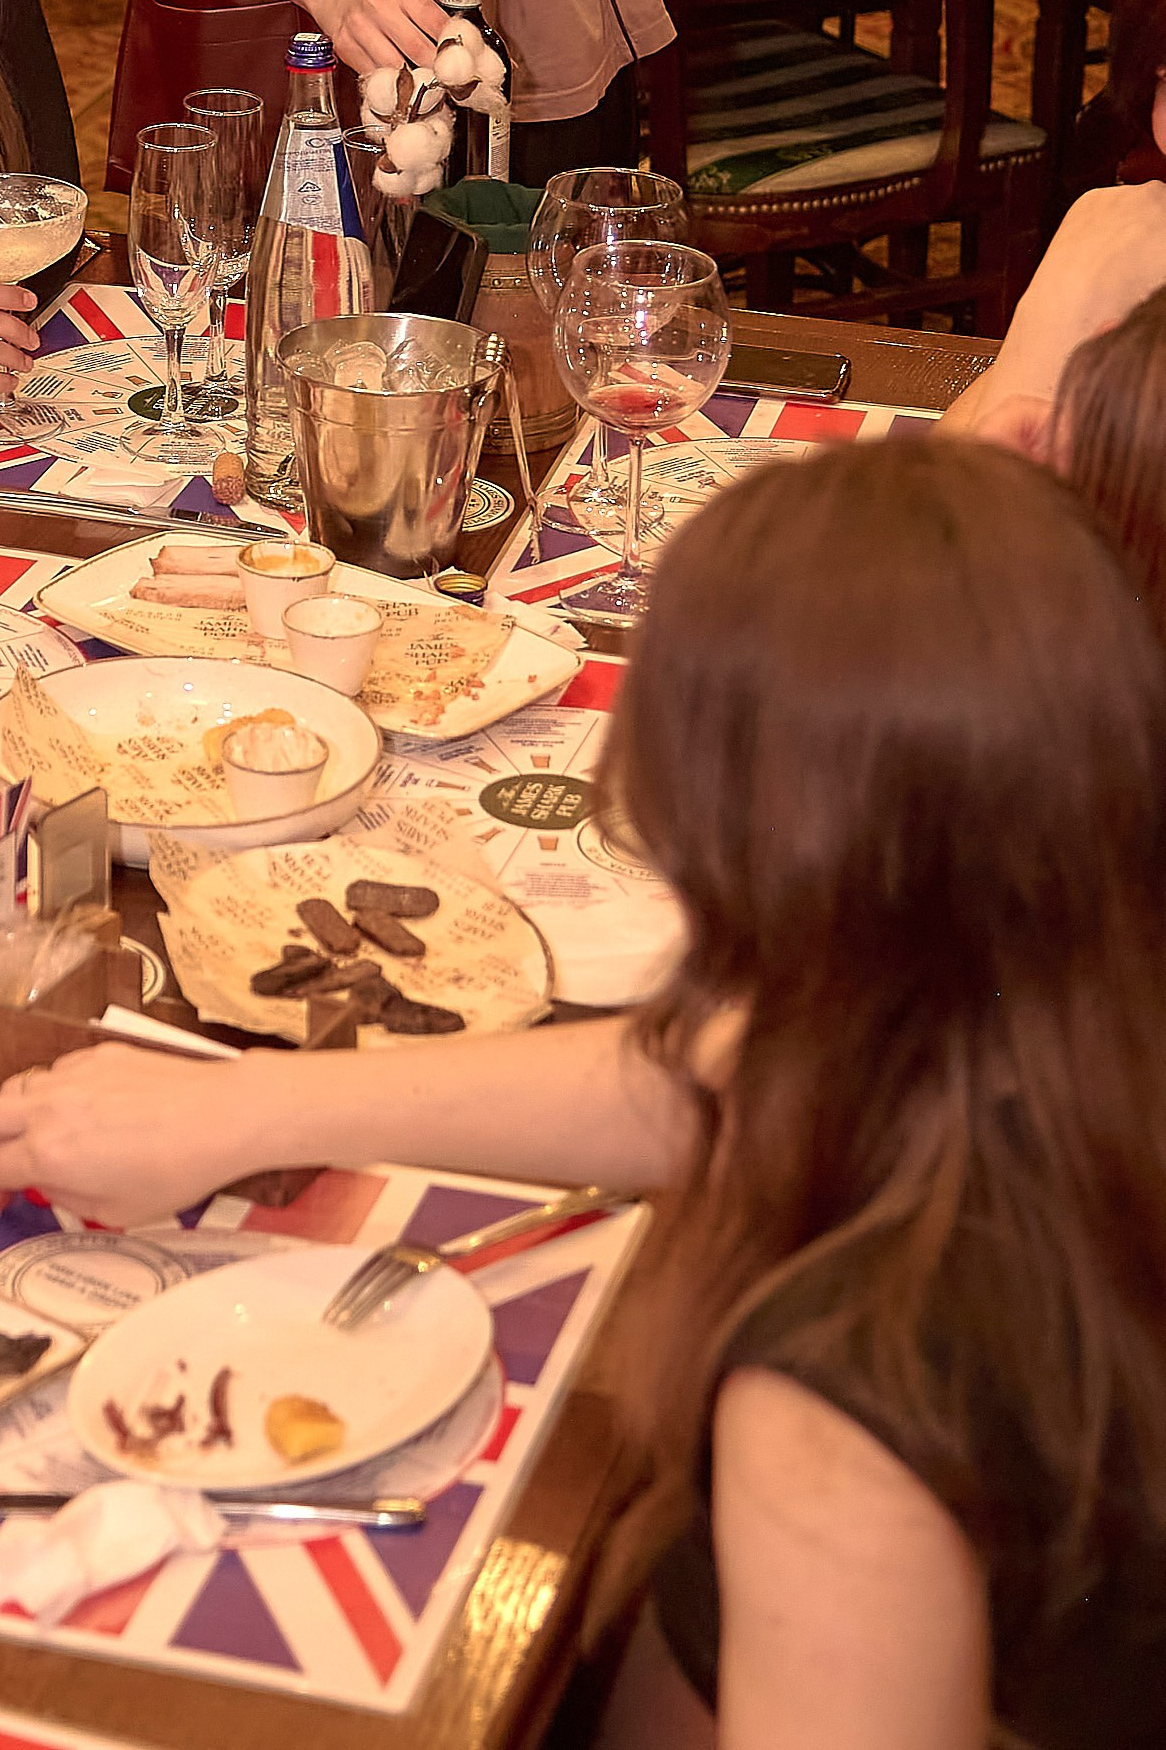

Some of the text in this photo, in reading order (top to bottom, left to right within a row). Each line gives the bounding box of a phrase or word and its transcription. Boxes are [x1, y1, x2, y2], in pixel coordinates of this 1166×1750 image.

[511, 781, 544, 815] JAMES
[529, 784, 566, 820] SHARK
[555, 793, 583, 817] PUB
